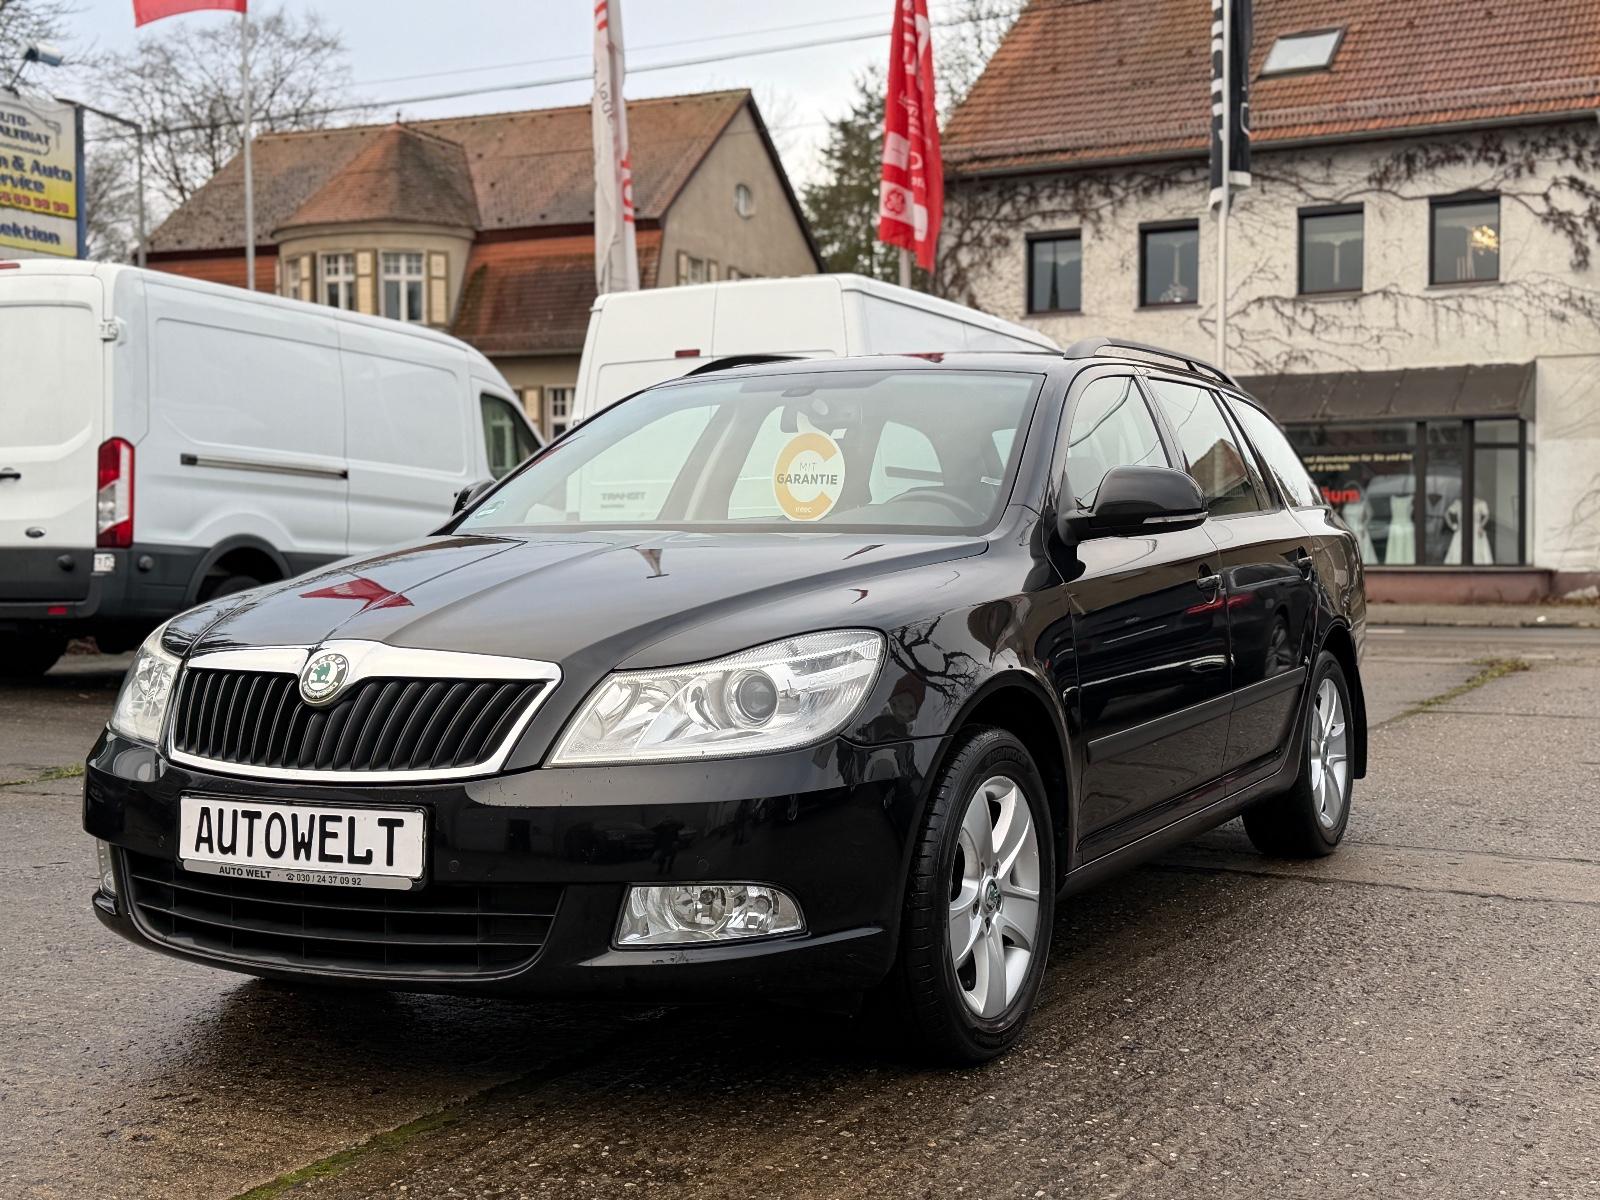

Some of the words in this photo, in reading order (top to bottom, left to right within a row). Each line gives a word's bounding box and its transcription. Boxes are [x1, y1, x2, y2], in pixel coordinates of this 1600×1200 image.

[12, 155, 26, 173] &
[30, 159, 72, 182] Auto
[800, 462, 817, 472] MIT
[776, 473, 838, 485] GARANTIE
[219, 866, 244, 877] AUTO
[245, 868, 272, 879] WELT
[296, 873, 310, 882] 030
[317, 874, 327, 884] 24
[328, 875, 338, 884] 37
[340, 876, 350, 885] 09
[351, 877, 362, 886] 92
